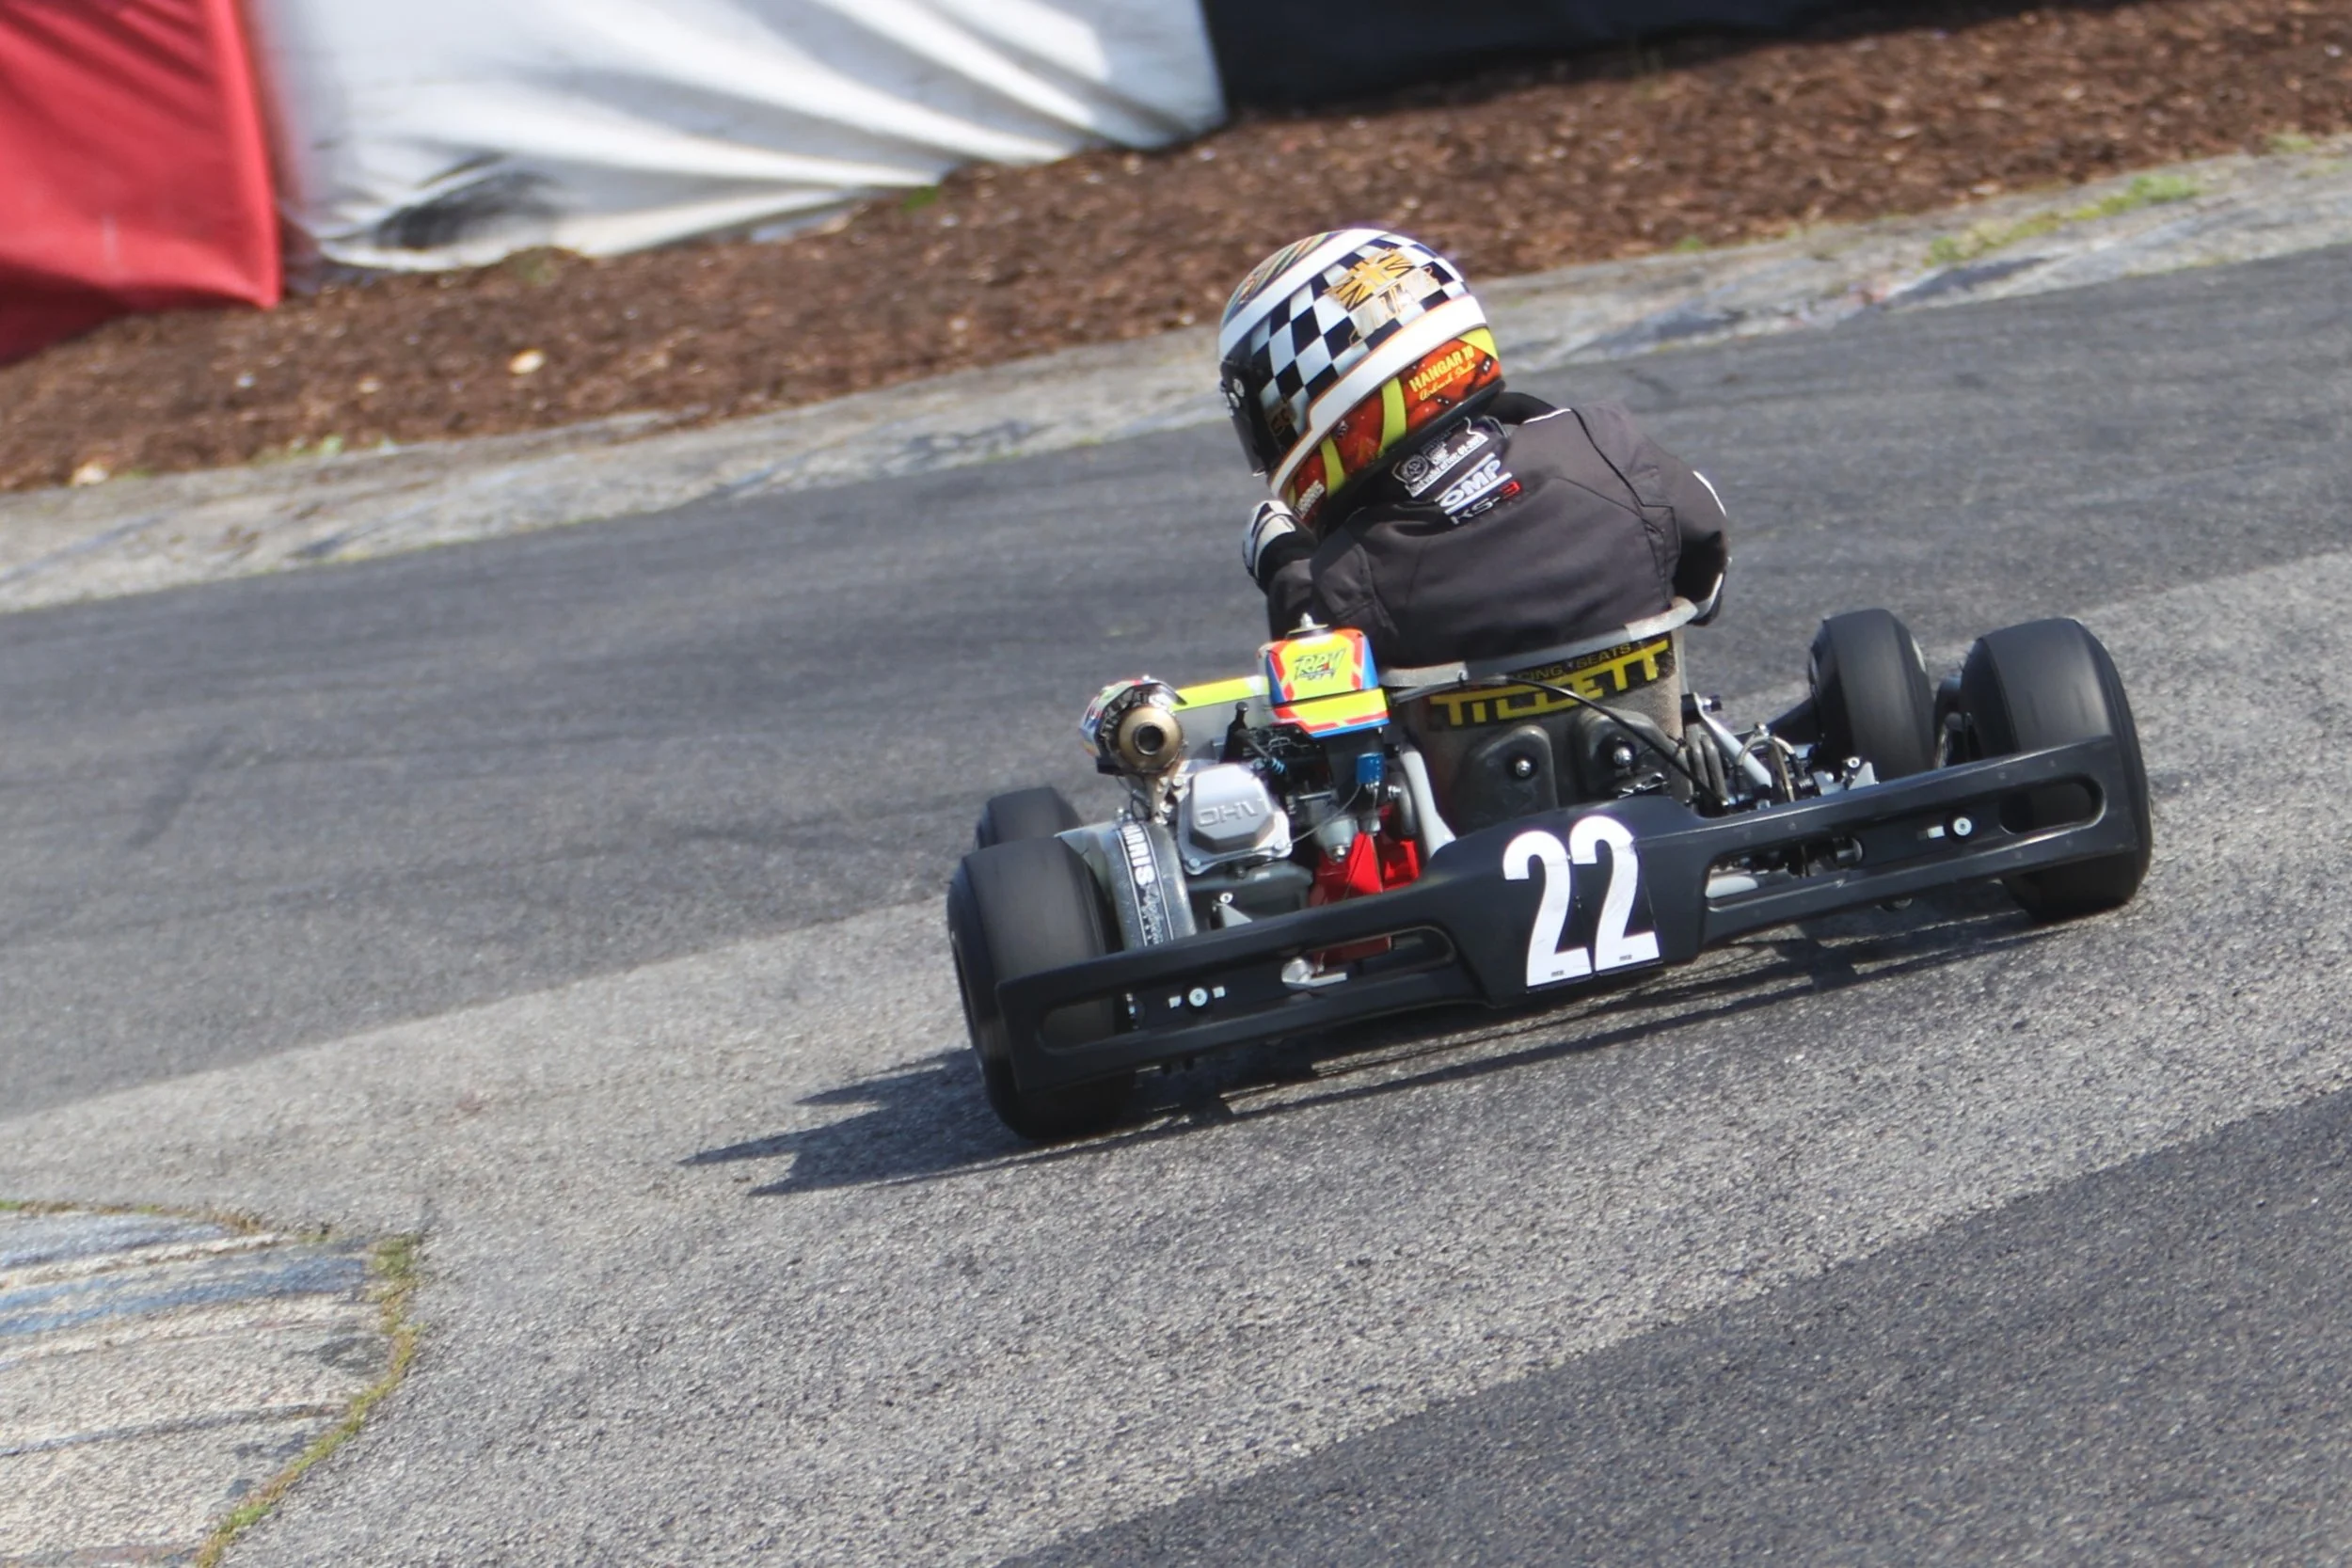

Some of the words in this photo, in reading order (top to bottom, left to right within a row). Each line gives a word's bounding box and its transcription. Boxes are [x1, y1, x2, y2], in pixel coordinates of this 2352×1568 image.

[1408, 351, 1464, 392] HANGAR
[1439, 459, 1501, 508] OMP
[1577, 643, 1631, 669] SEATS
[1429, 639, 1669, 726] TILLETT
[1502, 815, 1660, 987] 22
